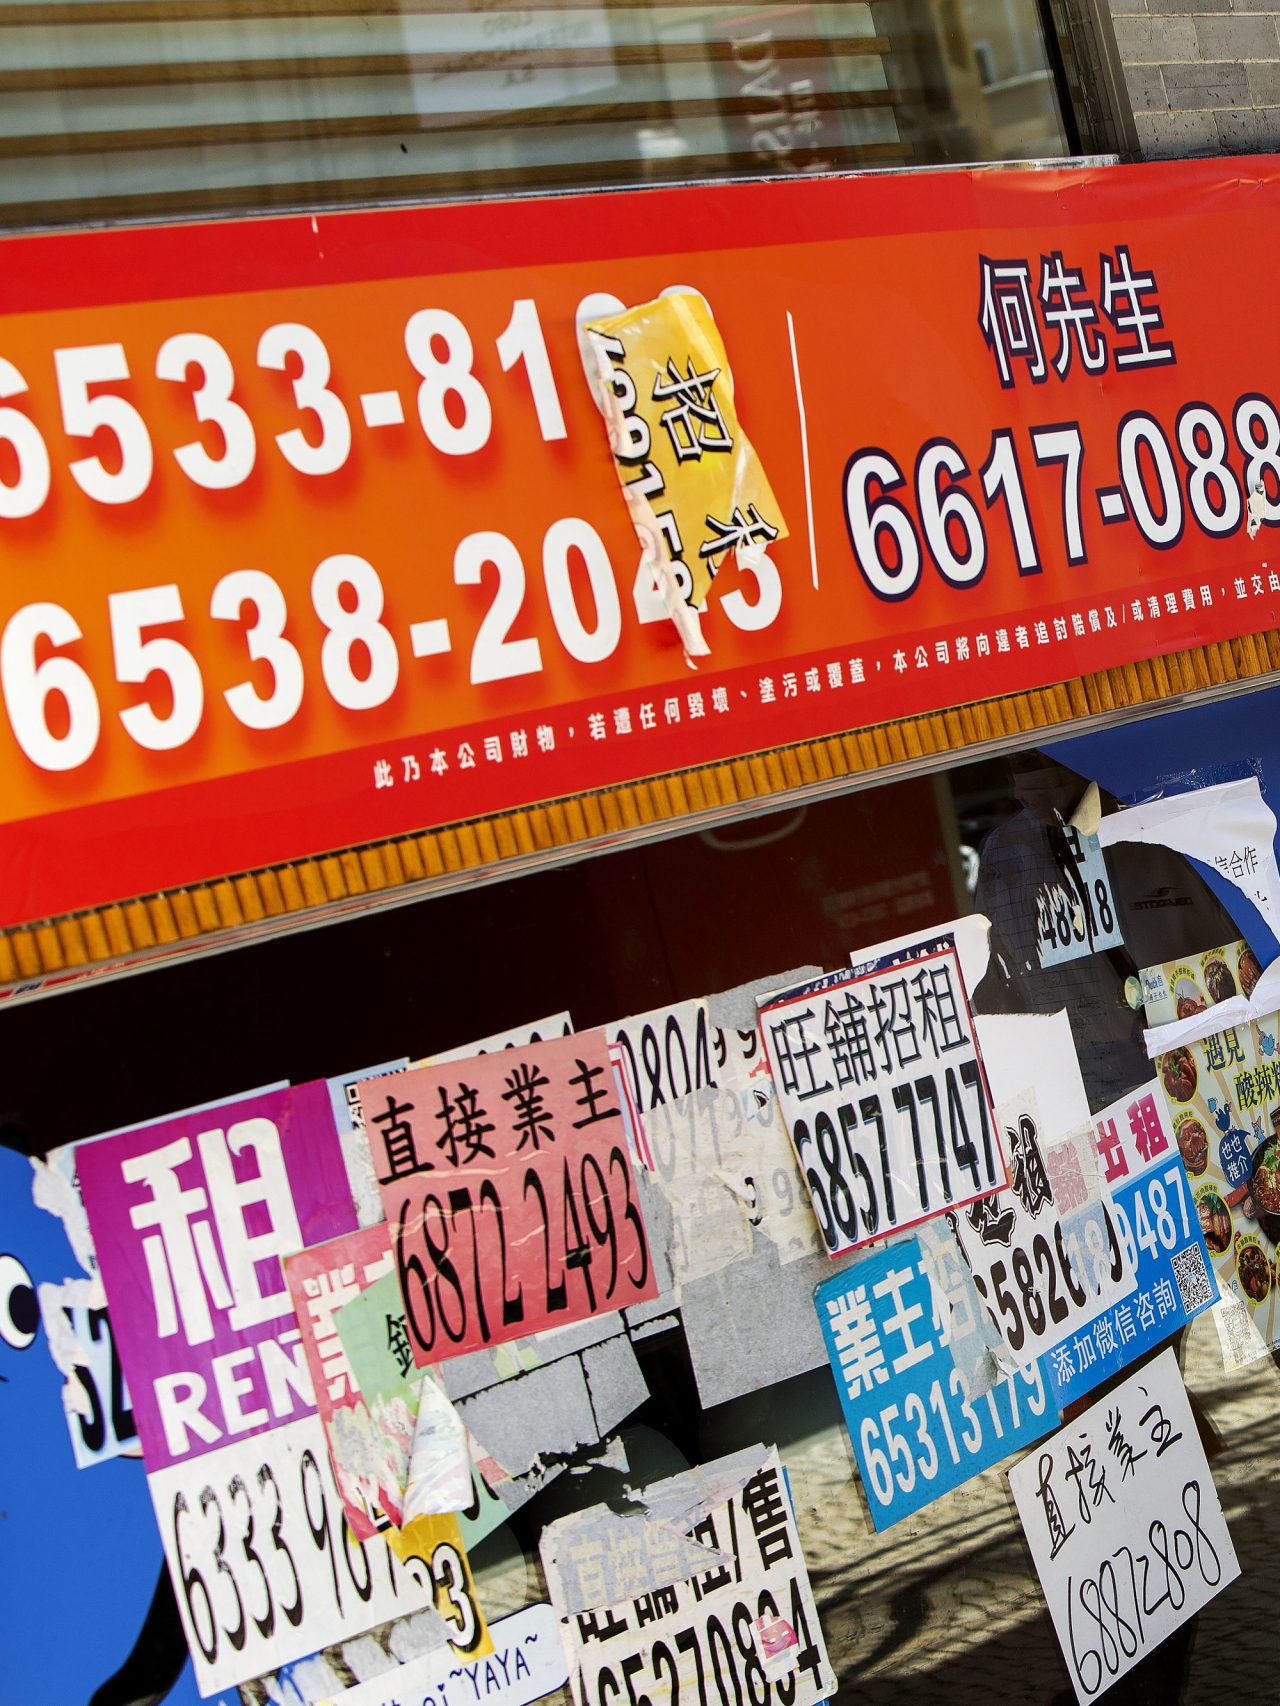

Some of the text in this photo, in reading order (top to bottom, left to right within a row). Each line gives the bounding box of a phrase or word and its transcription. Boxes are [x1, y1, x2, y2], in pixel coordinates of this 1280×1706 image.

[978, 245, 1177, 390] 何先生
[0, 285, 736, 521] 6533-81
[769, 964, 970, 1102] 旺舖招租
[372, 1058, 622, 1186] 直接業主
[793, 1093, 897, 1251] 6857
[891, 1059, 997, 1213] 7747
[1095, 1092, 1170, 1184] 出租
[1226, 1154, 1250, 1183] 推介
[120, 1116, 310, 1347] 租
[399, 1177, 526, 1353] 6872
[522, 1146, 649, 1315] 2493
[153, 1329, 318, 1458] REN
[1050, 1277, 1178, 1387] 添加微信咨詢
[1036, 1385, 1183, 1561] 直接業主
[174, 1452, 304, 1665] 6333
[1068, 1479, 1222, 1696] 68872808
